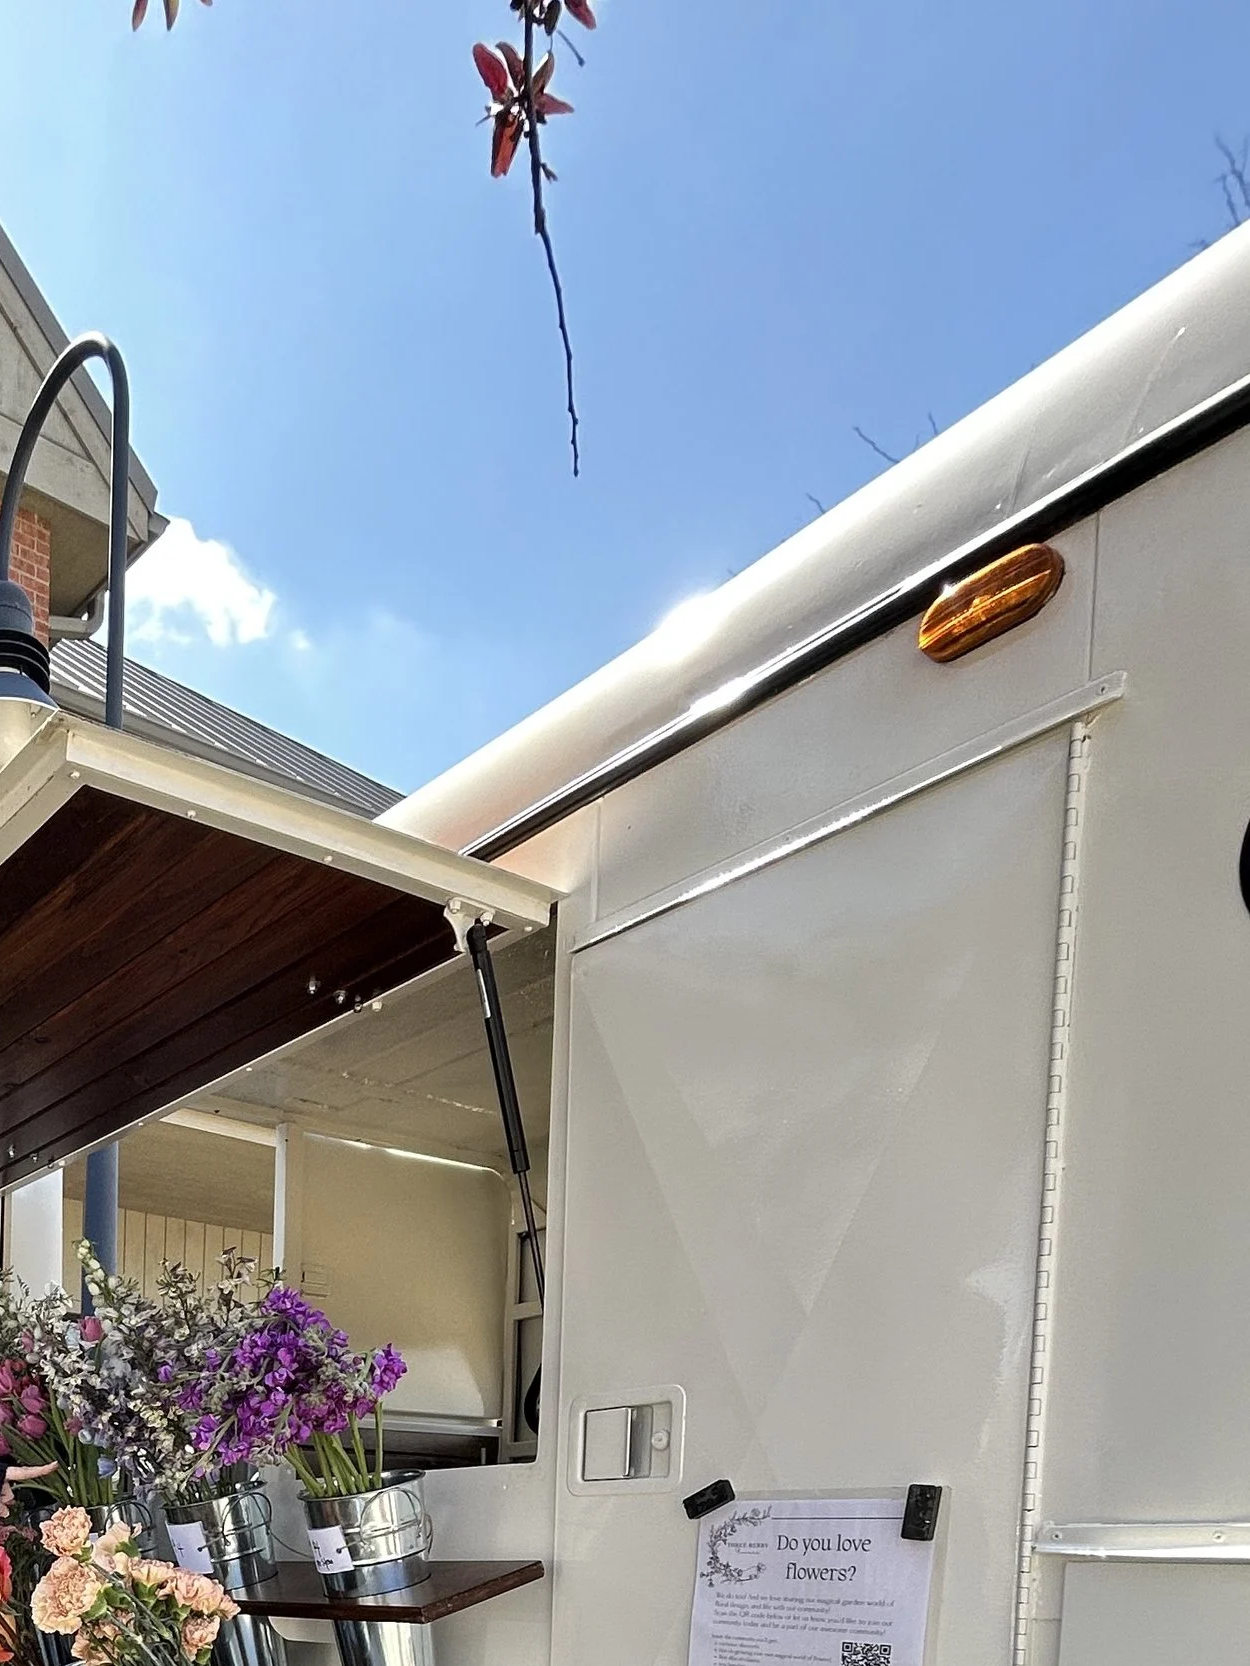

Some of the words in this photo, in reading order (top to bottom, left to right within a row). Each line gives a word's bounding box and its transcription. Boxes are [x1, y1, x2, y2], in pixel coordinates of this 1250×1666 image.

[777, 1534, 799, 1551] Do
[802, 1537, 832, 1556] you
[836, 1533, 872, 1552] love
[785, 1561, 857, 1582] flowers?
